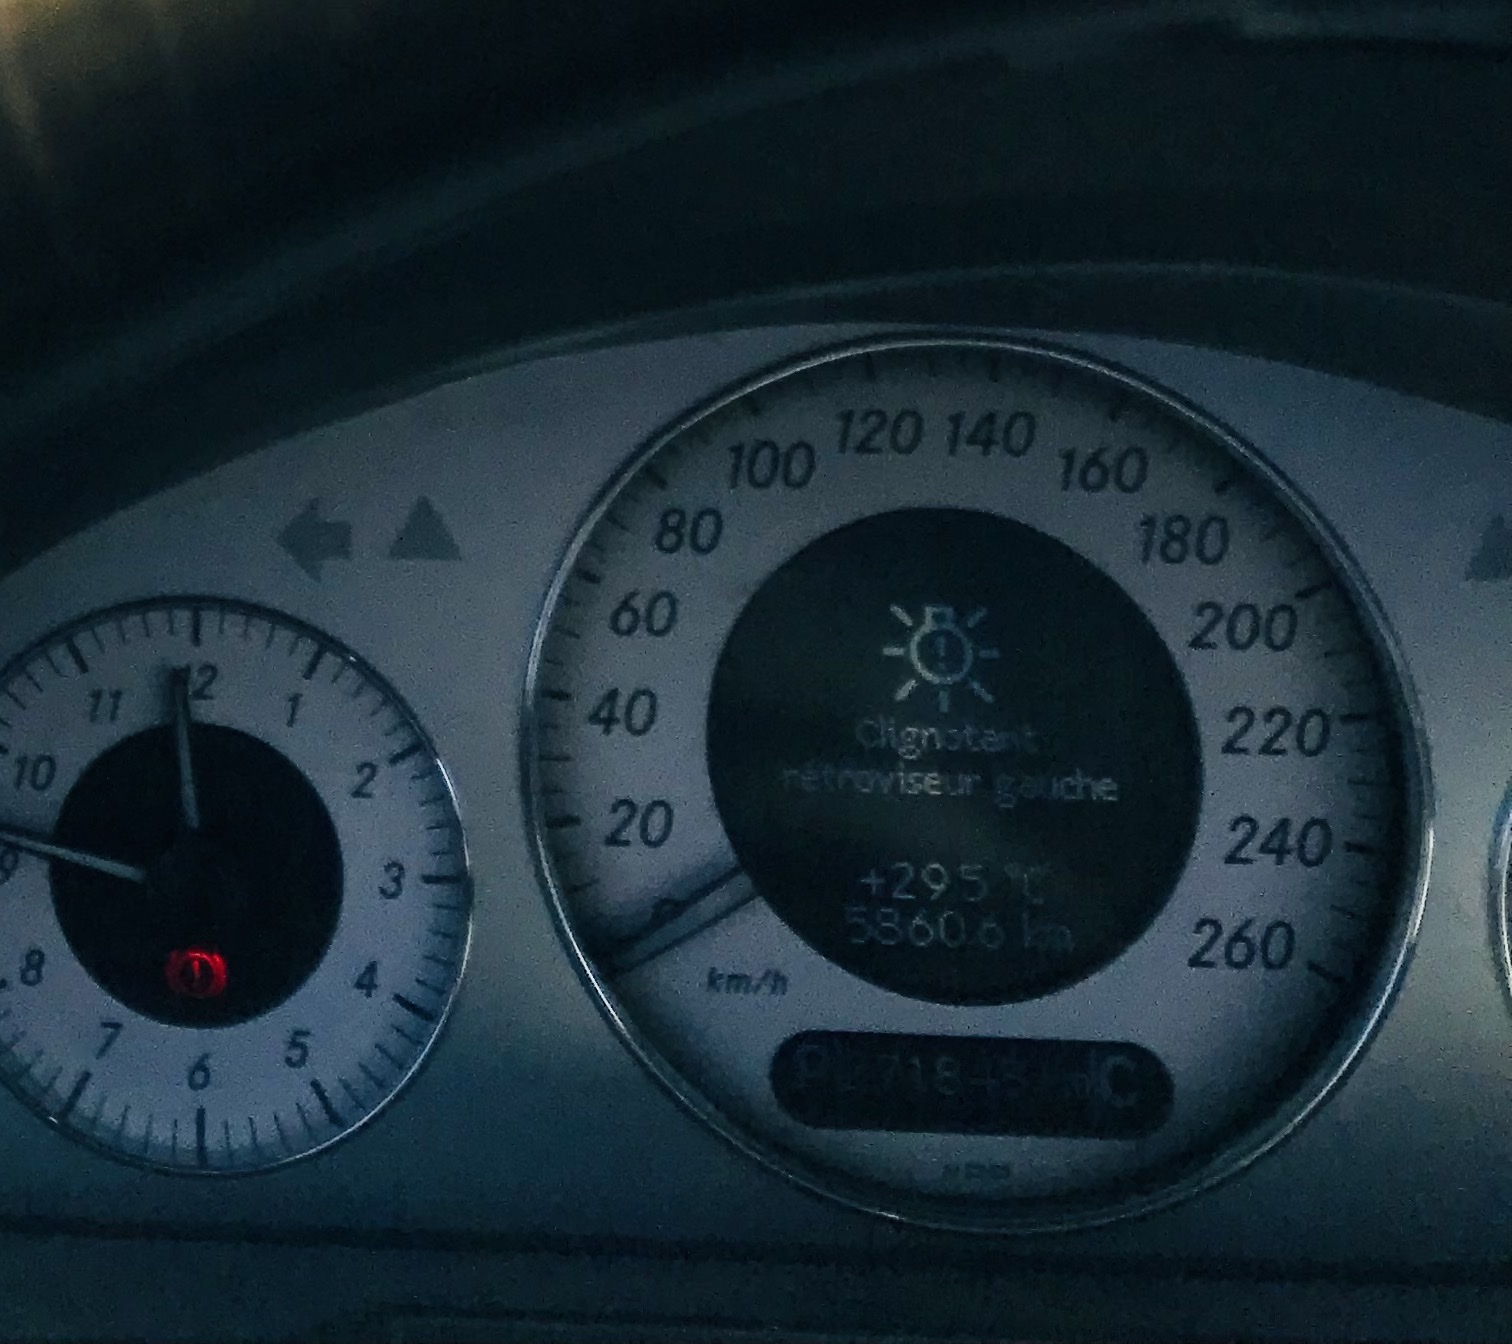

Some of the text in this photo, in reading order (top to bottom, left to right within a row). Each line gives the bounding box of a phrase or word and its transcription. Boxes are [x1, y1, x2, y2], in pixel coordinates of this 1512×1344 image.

[838, 409, 924, 455] 120
[947, 411, 1037, 458] 140
[729, 439, 817, 490] 100
[1060, 446, 1149, 494] 160
[654, 507, 724, 556] 80
[1139, 513, 1230, 566] 180
[609, 590, 679, 638] 60
[1187, 600, 1296, 652] 200
[89, 688, 123, 723] 11
[286, 692, 303, 728] 1
[587, 687, 658, 737] 40
[1221, 705, 1330, 757] 220
[14, 754, 57, 793] 10
[350, 761, 378, 799] 2
[993, 768, 1119, 809] gauche
[603, 798, 674, 849] 20
[1223, 814, 1332, 867] 240
[378, 860, 406, 900] 3
[1187, 917, 1294, 970] 260
[19, 947, 46, 987] 8
[353, 960, 379, 998] 4
[707, 967, 788, 995] km/h
[97, 1020, 124, 1058] 7
[284, 1028, 312, 1069] 5
[187, 1052, 211, 1092] 6
